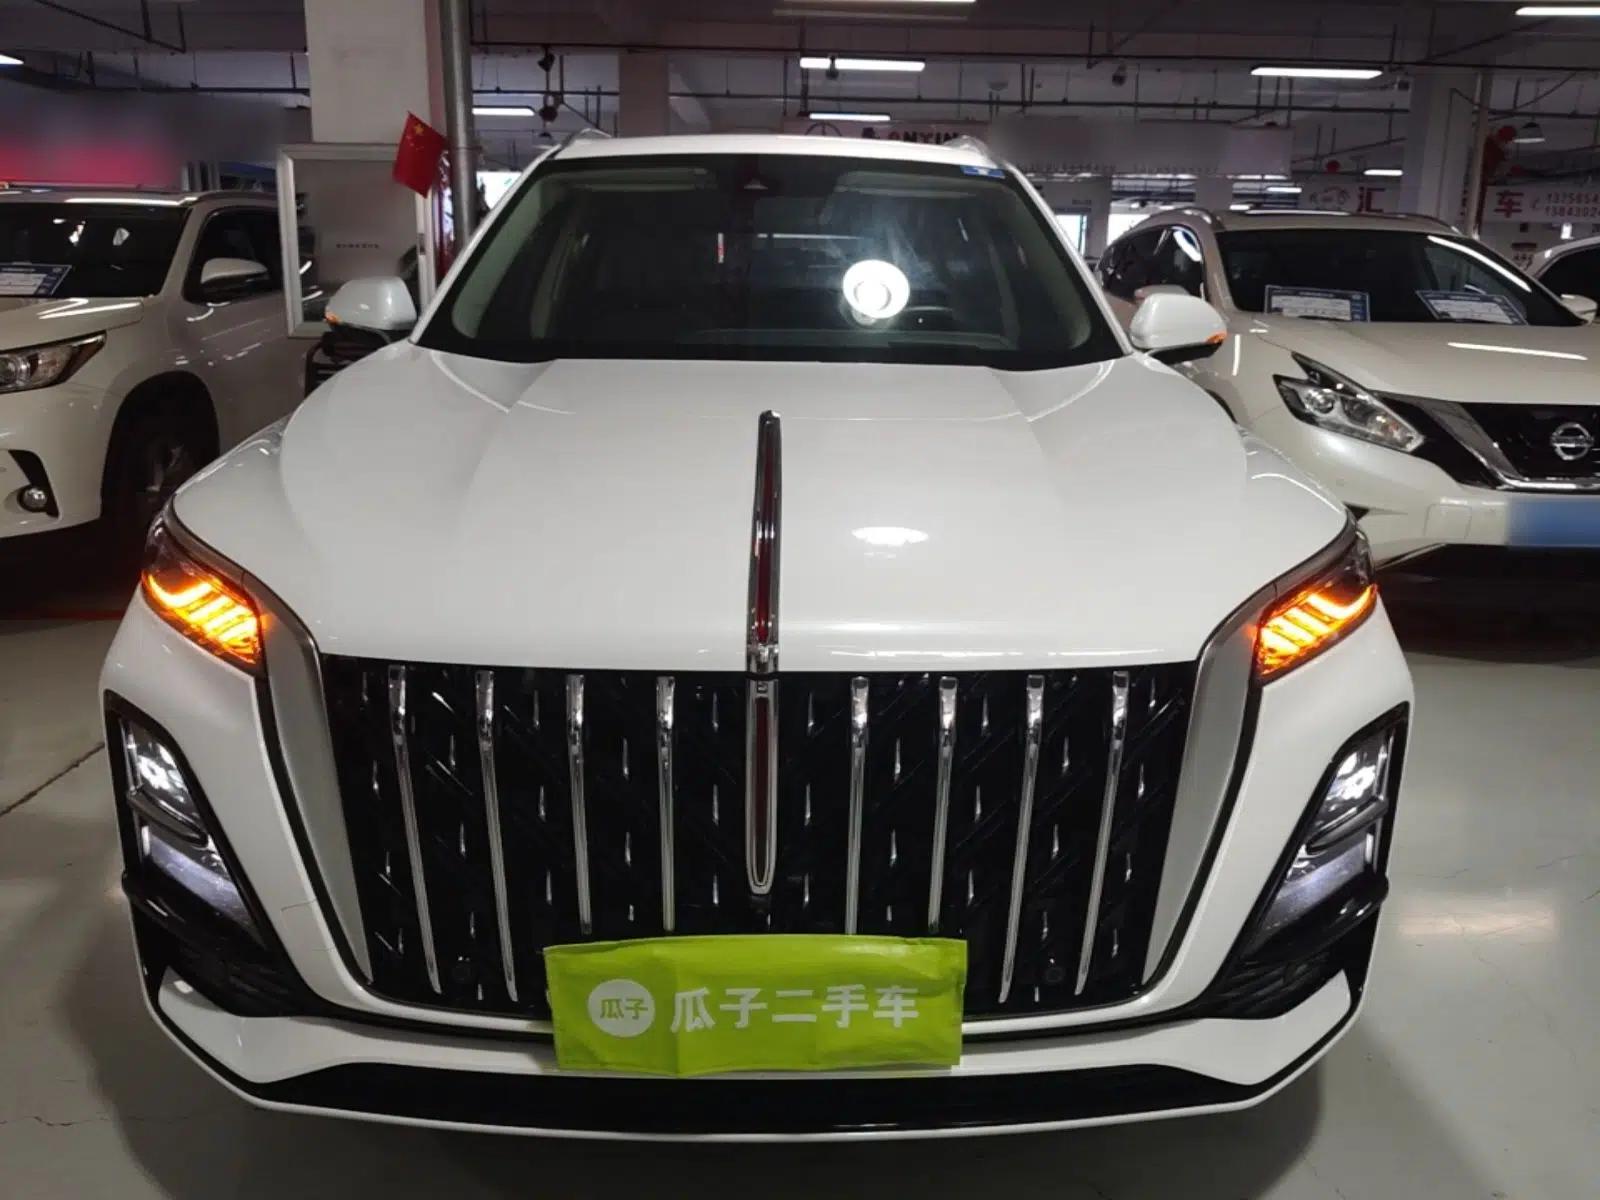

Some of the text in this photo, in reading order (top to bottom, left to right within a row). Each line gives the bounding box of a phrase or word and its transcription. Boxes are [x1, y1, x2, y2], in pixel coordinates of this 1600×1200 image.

[1494, 190, 1524, 218] 车
[600, 998, 648, 1020] 瓜子
[670, 984, 919, 1033] 瓜子二手车
